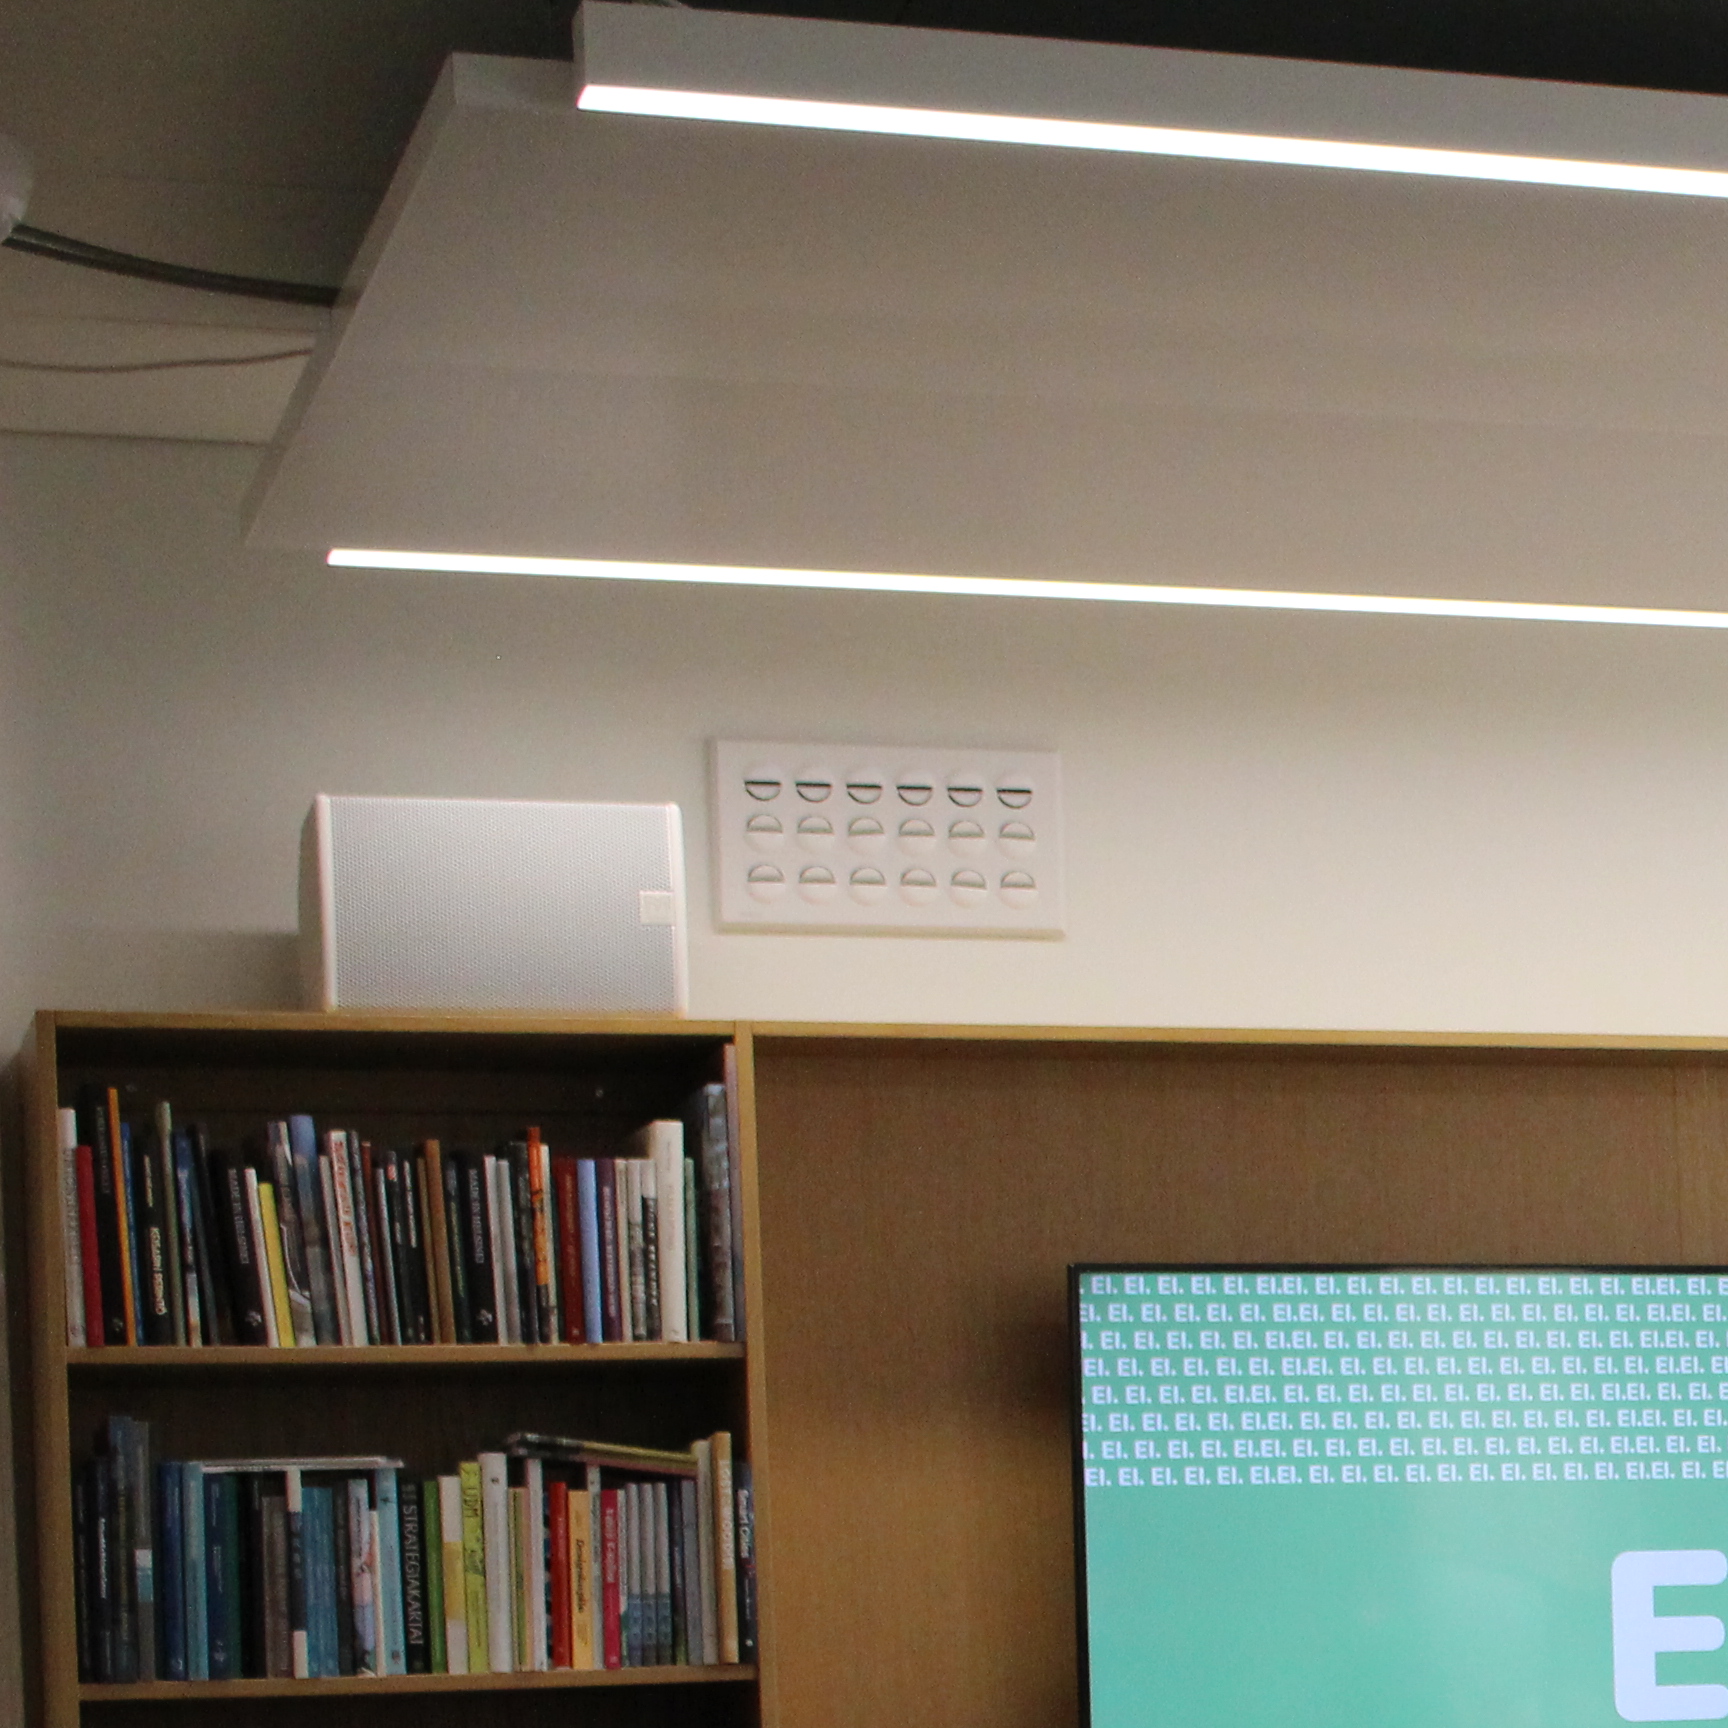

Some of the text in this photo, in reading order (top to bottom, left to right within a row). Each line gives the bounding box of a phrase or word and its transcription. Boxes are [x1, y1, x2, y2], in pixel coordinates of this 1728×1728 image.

[1108, 1302, 1134, 1322] EI.
[1140, 1302, 1167, 1322] EI.
[1174, 1303, 1200, 1322] EI.
[1206, 1302, 1232, 1322] EI.
[1240, 1303, 1266, 1322] EI.
[1331, 1303, 1356, 1322] EI.
[1364, 1303, 1388, 1321] EI.
[1396, 1303, 1420, 1321] EI.
[1428, 1304, 1452, 1321] EI.
[1460, 1304, 1484, 1321] EI.
[1492, 1304, 1515, 1321] EI.
[1118, 1467, 1144, 1486] EI.
[1151, 1467, 1178, 1486] EI.
[1184, 1466, 1211, 1485] EI.
[1217, 1466, 1243, 1484] EI.
[1309, 1465, 1334, 1483] EI.
[1342, 1464, 1367, 1482] EI.
[1374, 1464, 1399, 1482] EI.
[1406, 1464, 1431, 1482] EI.
[1438, 1464, 1462, 1481] EI.
[1470, 1464, 1494, 1480] EI.
[1502, 1464, 1526, 1480] EI.
[1533, 1463, 1556, 1480] EI.
[1564, 1462, 1588, 1480] EI.
[1595, 1462, 1619, 1480] EI.
[1682, 1461, 1706, 1478] EI.
